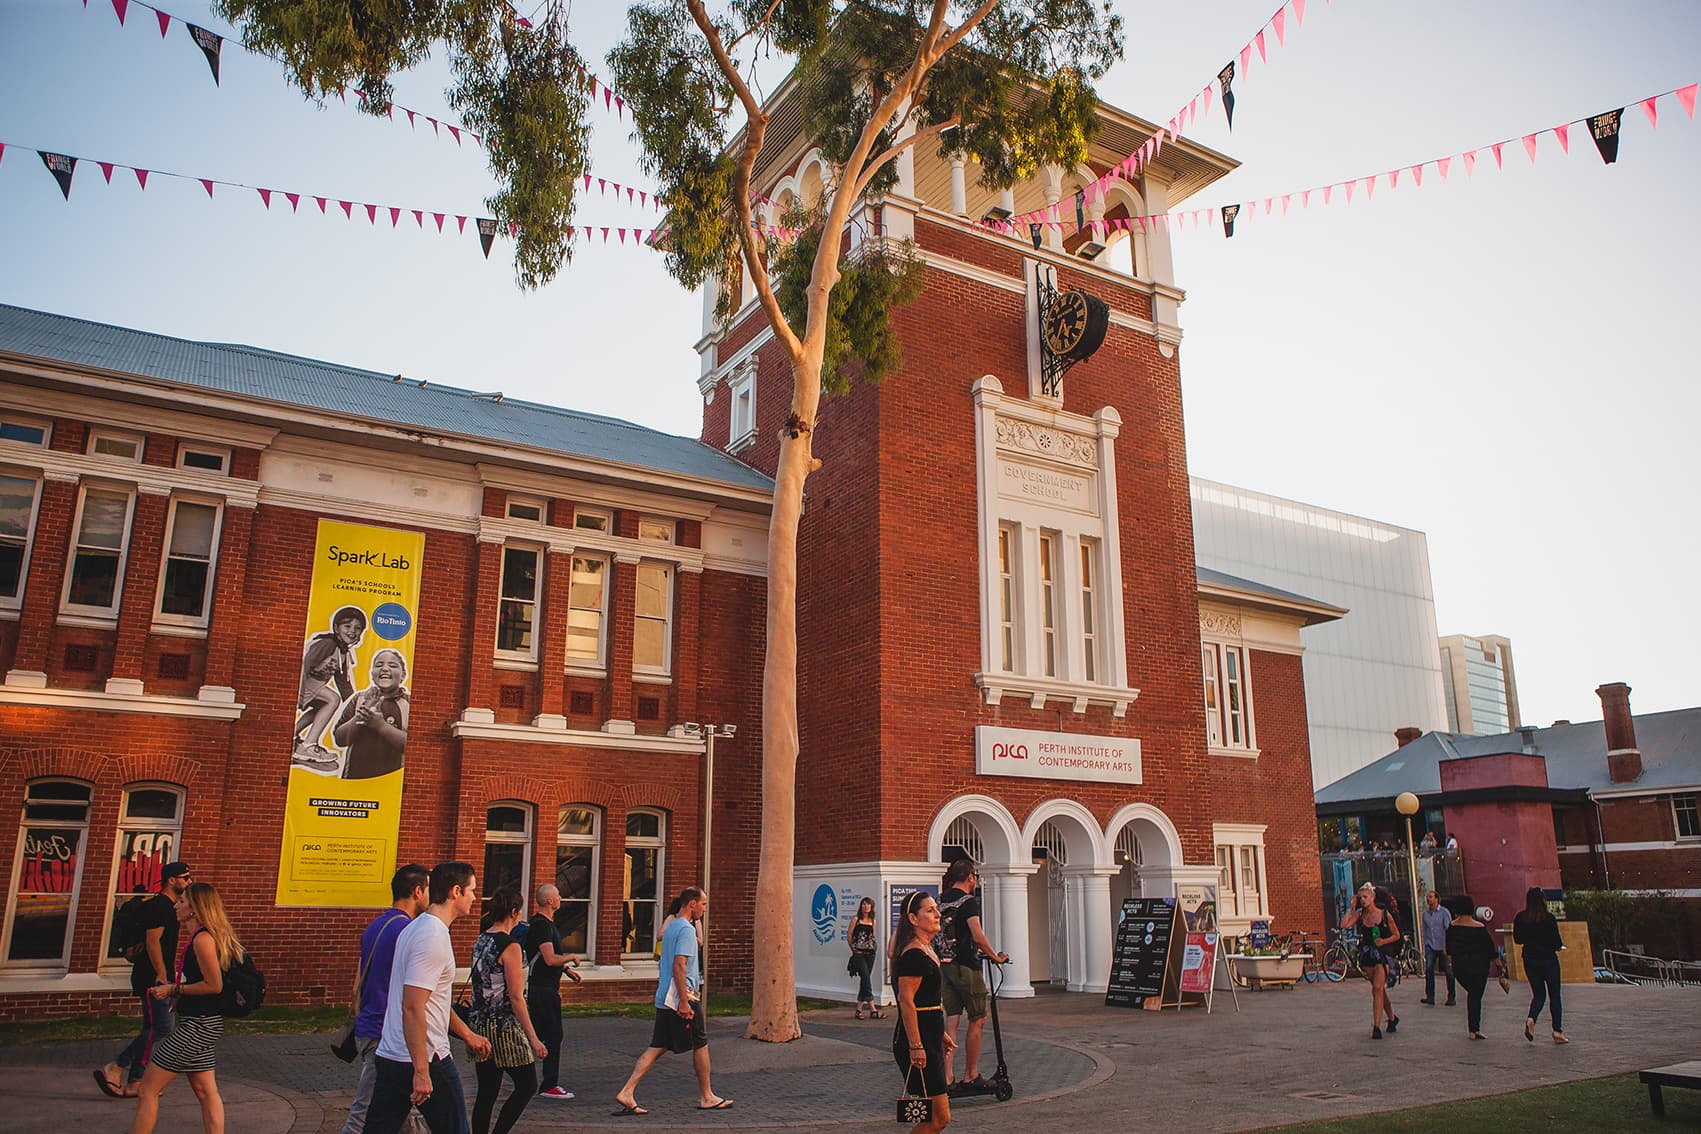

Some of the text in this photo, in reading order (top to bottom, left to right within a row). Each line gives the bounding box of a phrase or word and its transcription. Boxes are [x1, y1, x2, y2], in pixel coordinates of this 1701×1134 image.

[1005, 465, 1083, 492] GOVERNMENT
[1022, 483, 1067, 501] SCHOOL
[332, 583, 401, 597] LEARNING PROGRAM
[339, 578, 396, 590] PICA'S SCHOOLS
[1038, 743, 1067, 754] PERTH
[1068, 745, 1109, 758] INSTITUTE
[1111, 748, 1124, 759] OF
[1038, 756, 1133, 772] CONTEMPORARY ARTS
[311, 799, 377, 809] GROWING FUTURE
[320, 809, 367, 817] INNOVATORS
